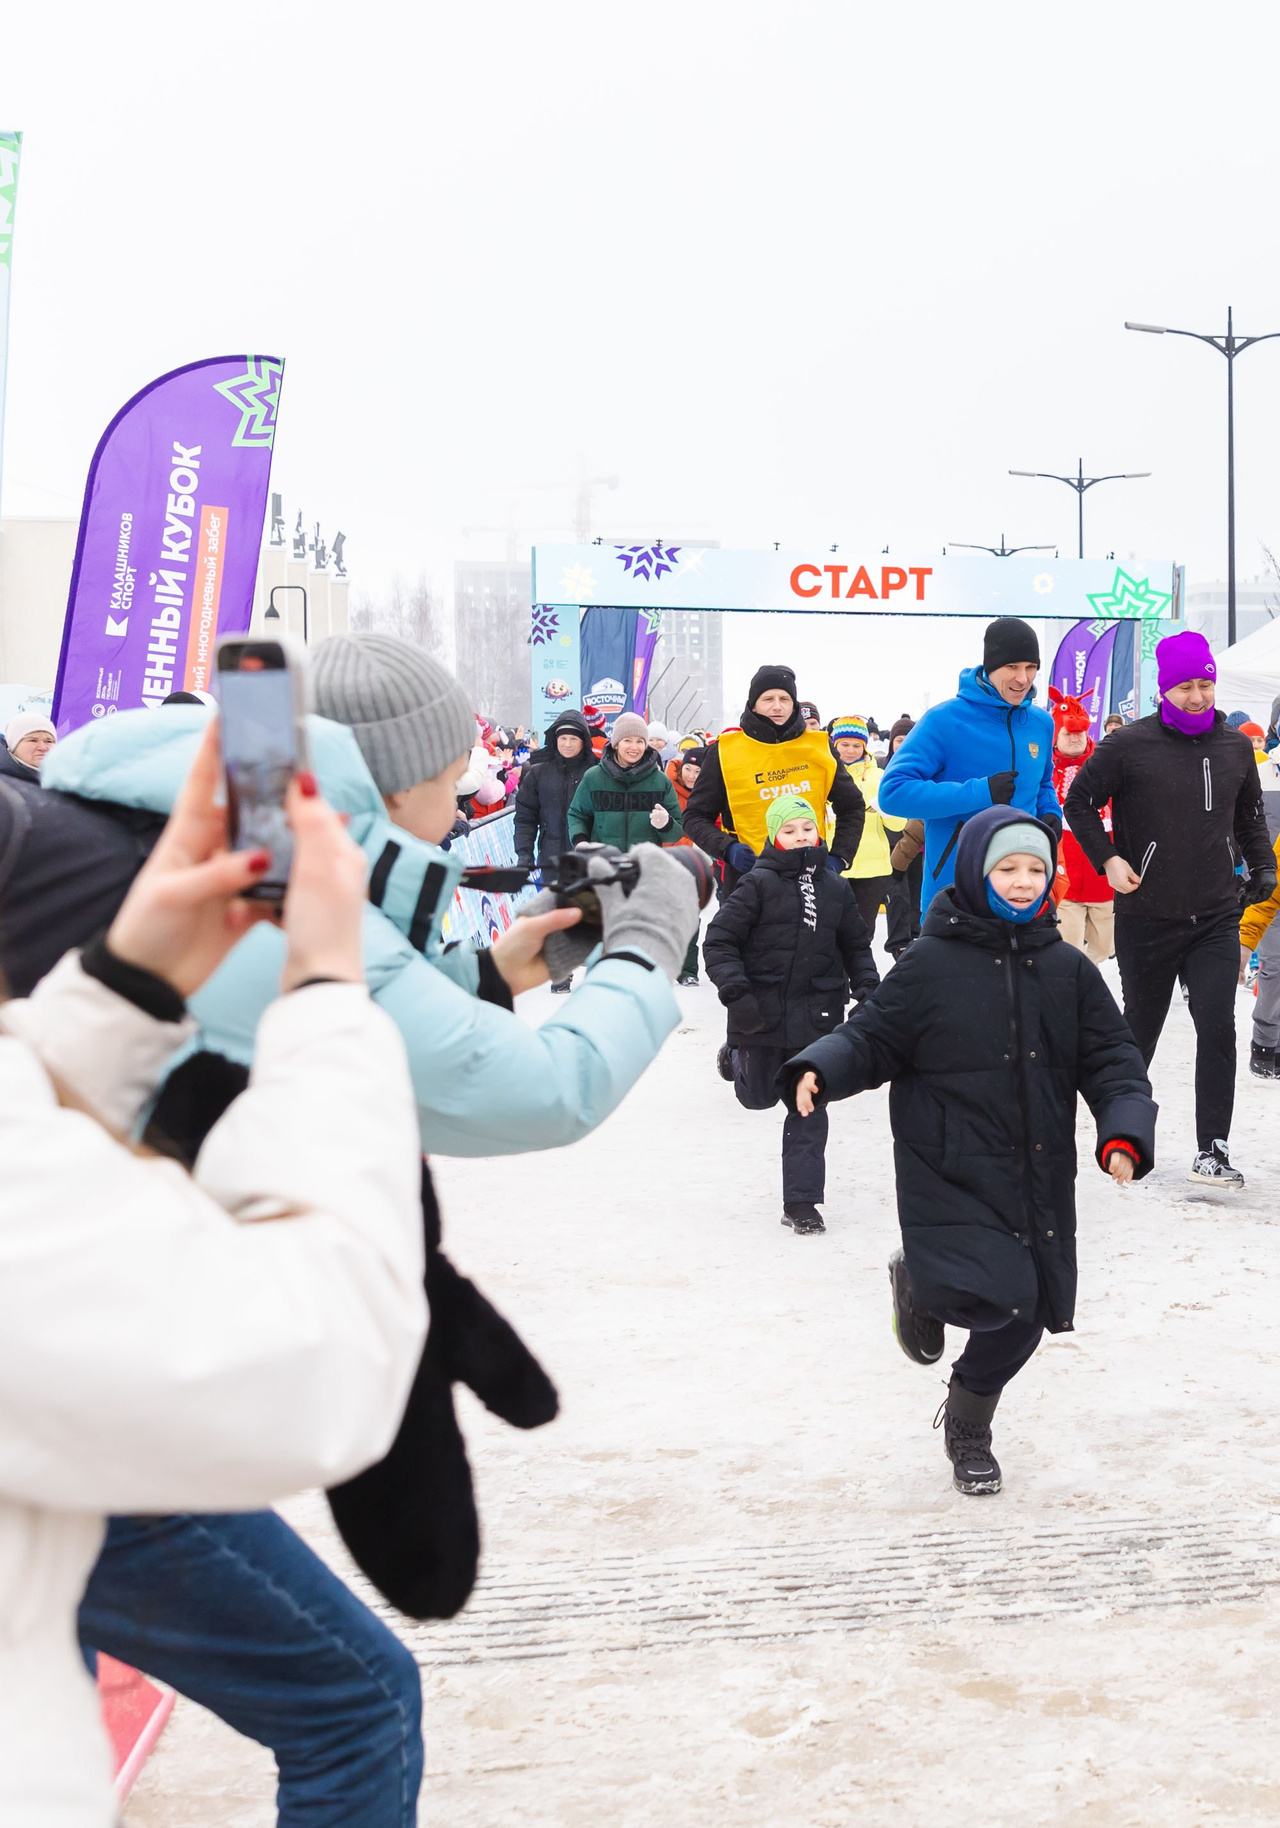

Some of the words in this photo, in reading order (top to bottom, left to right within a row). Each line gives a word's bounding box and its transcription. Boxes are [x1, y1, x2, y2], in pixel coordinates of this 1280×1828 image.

[160, 441, 202, 562] КУБОК
[205, 513, 221, 554] забег
[110, 512, 133, 609] КАЛАШНИКОВ
[790, 564, 933, 600] СТАРТ
[121, 566, 137, 610] СПОРТ
[197, 557, 218, 662] многодневный
[141, 569, 187, 707] ЕННЫЙ
[759, 780, 811, 800] СУДЬЯ
[767, 764, 809, 777] КАЛАШНИКОВ
[768, 773, 789, 782] СПОРТ
[798, 864, 817, 932] TERMIT
